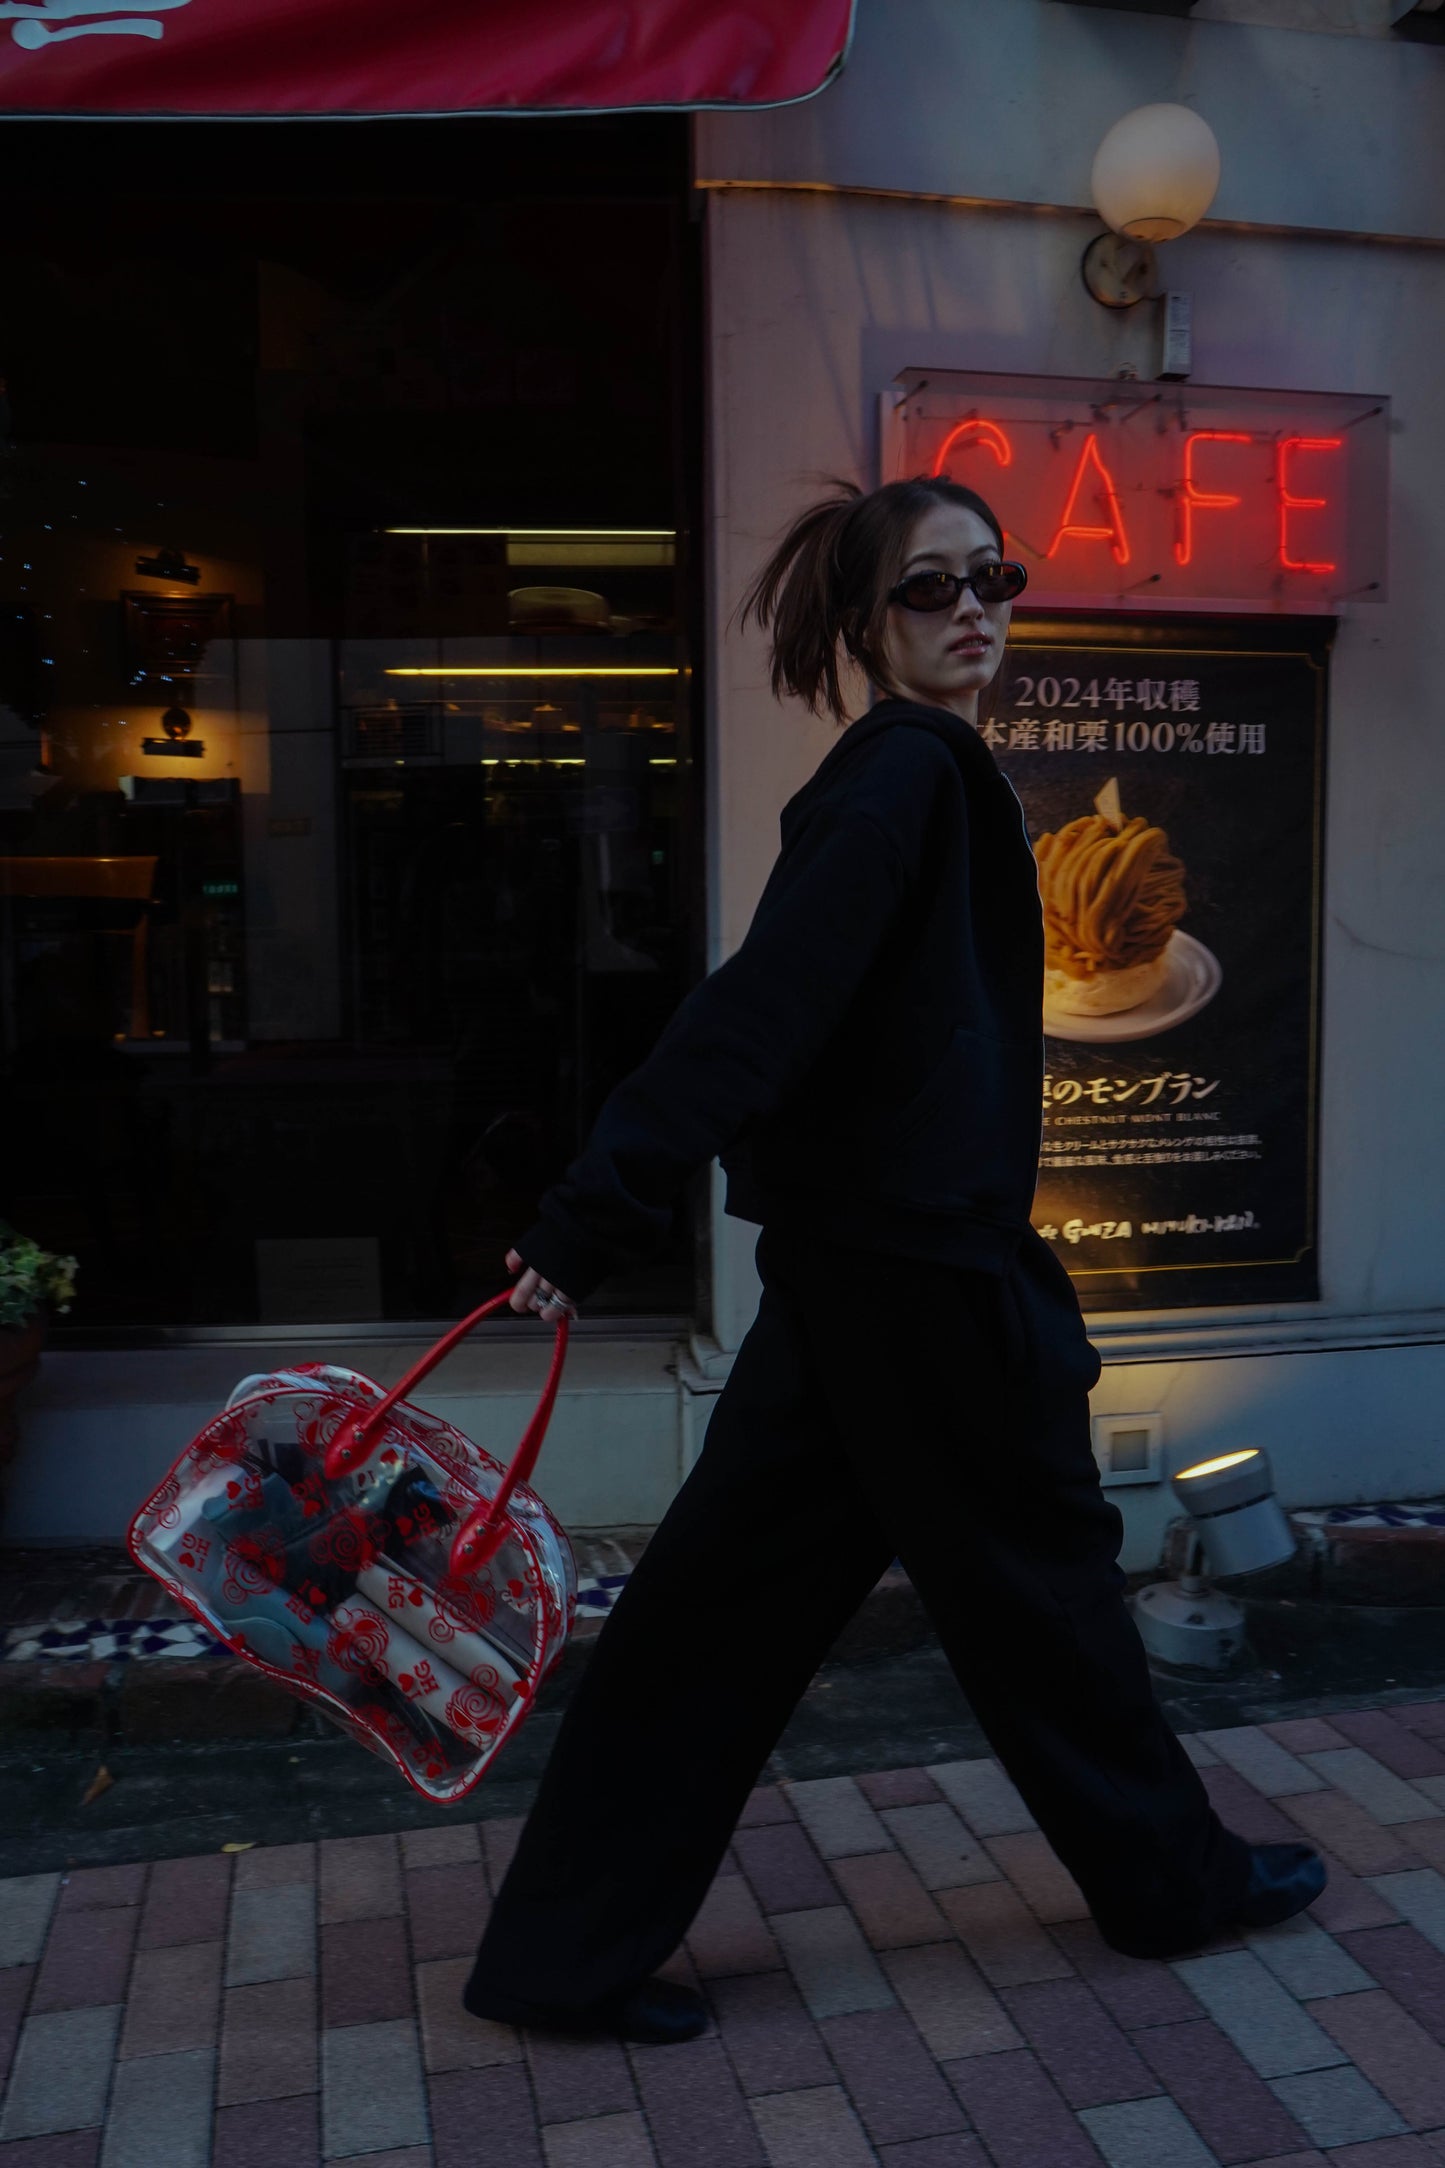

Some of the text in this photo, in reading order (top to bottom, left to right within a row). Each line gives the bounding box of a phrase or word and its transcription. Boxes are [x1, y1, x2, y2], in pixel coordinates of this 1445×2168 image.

[1014, 676, 1202, 712] 2024年収穫
[1054, 1114, 1126, 1126] CHESTNUT
[1130, 1112, 1173, 1124] MONT
[1176, 1111, 1223, 1122] BLANC
[387, 1576, 404, 1608] HG
[413, 1660, 439, 1694] HG
